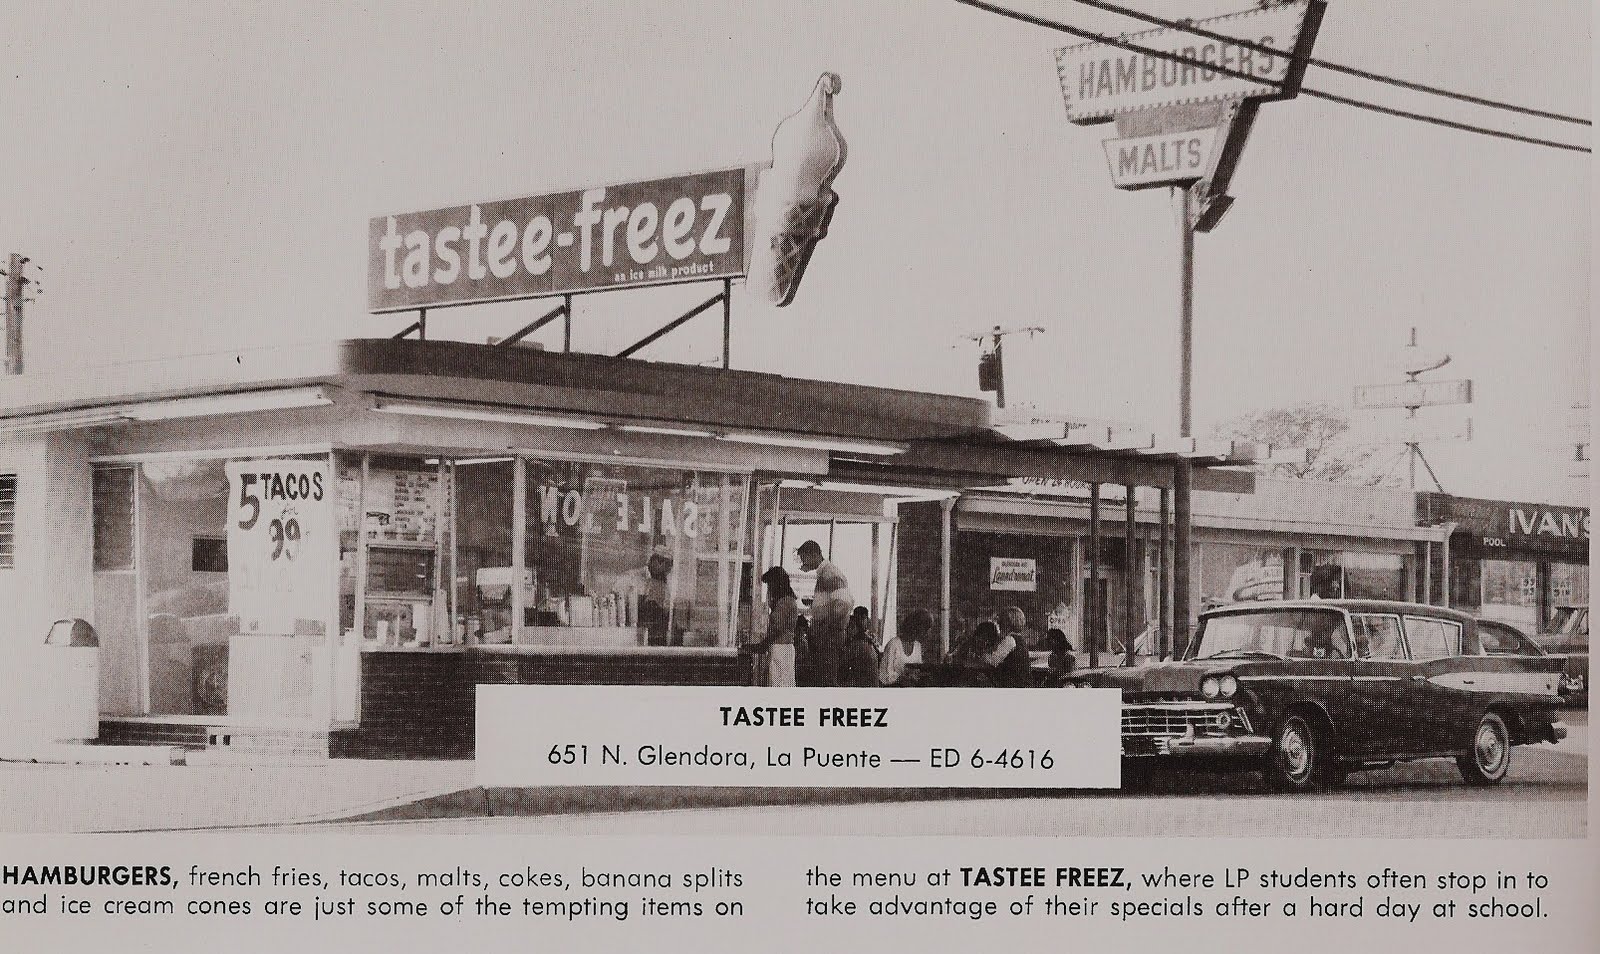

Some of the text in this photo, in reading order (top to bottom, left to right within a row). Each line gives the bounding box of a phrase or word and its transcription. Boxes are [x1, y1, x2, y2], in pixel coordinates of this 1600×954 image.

[1078, 35, 1276, 100] HAMBURGERS
[1118, 137, 1201, 177] MALTS
[379, 187, 733, 290] tastee-freez
[614, 260, 714, 282] an ice milk product
[238, 473, 260, 531] 5
[260, 471, 324, 502] TACOS
[1483, 536, 1507, 547] POOL
